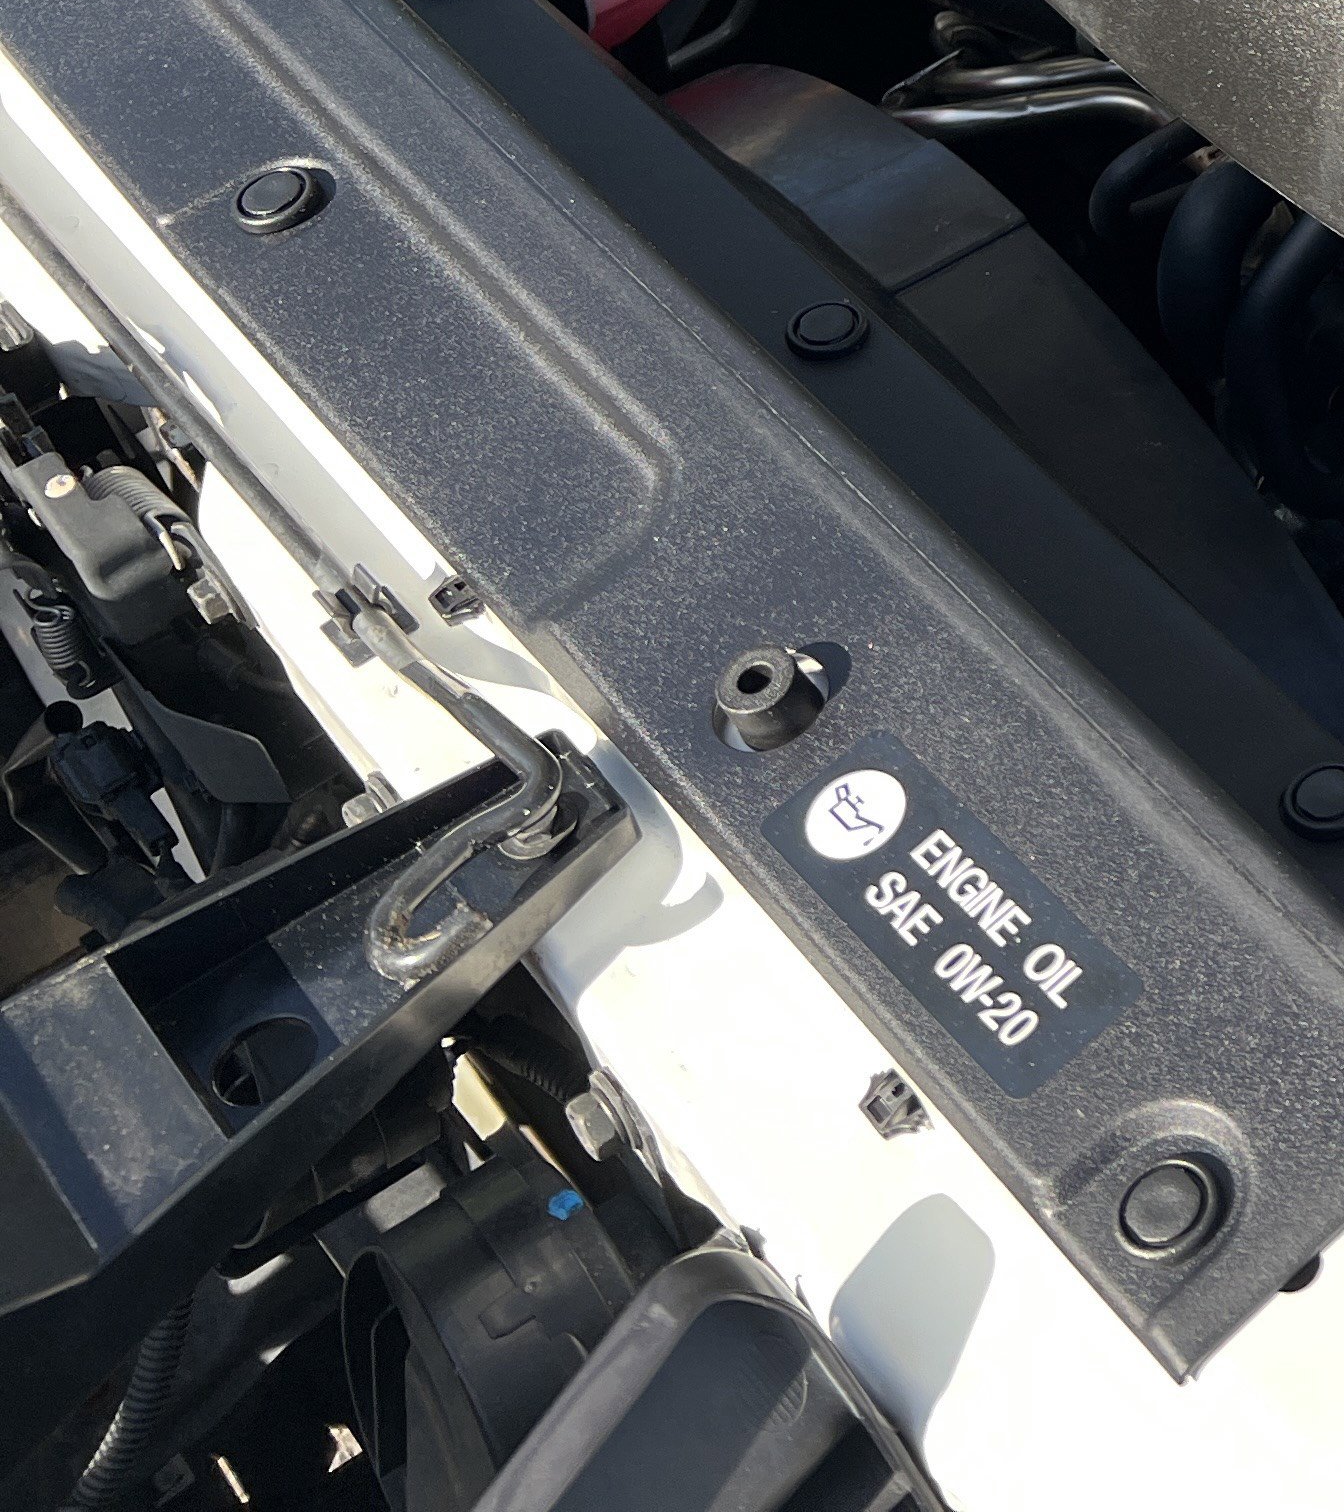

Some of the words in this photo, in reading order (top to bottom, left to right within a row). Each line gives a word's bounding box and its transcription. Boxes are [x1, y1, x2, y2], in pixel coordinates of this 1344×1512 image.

[865, 870, 944, 948] SAE
[934, 942, 1039, 1047] 0W-20
[909, 828, 1033, 949] ENGINE
[1023, 943, 1084, 1011] OIL
